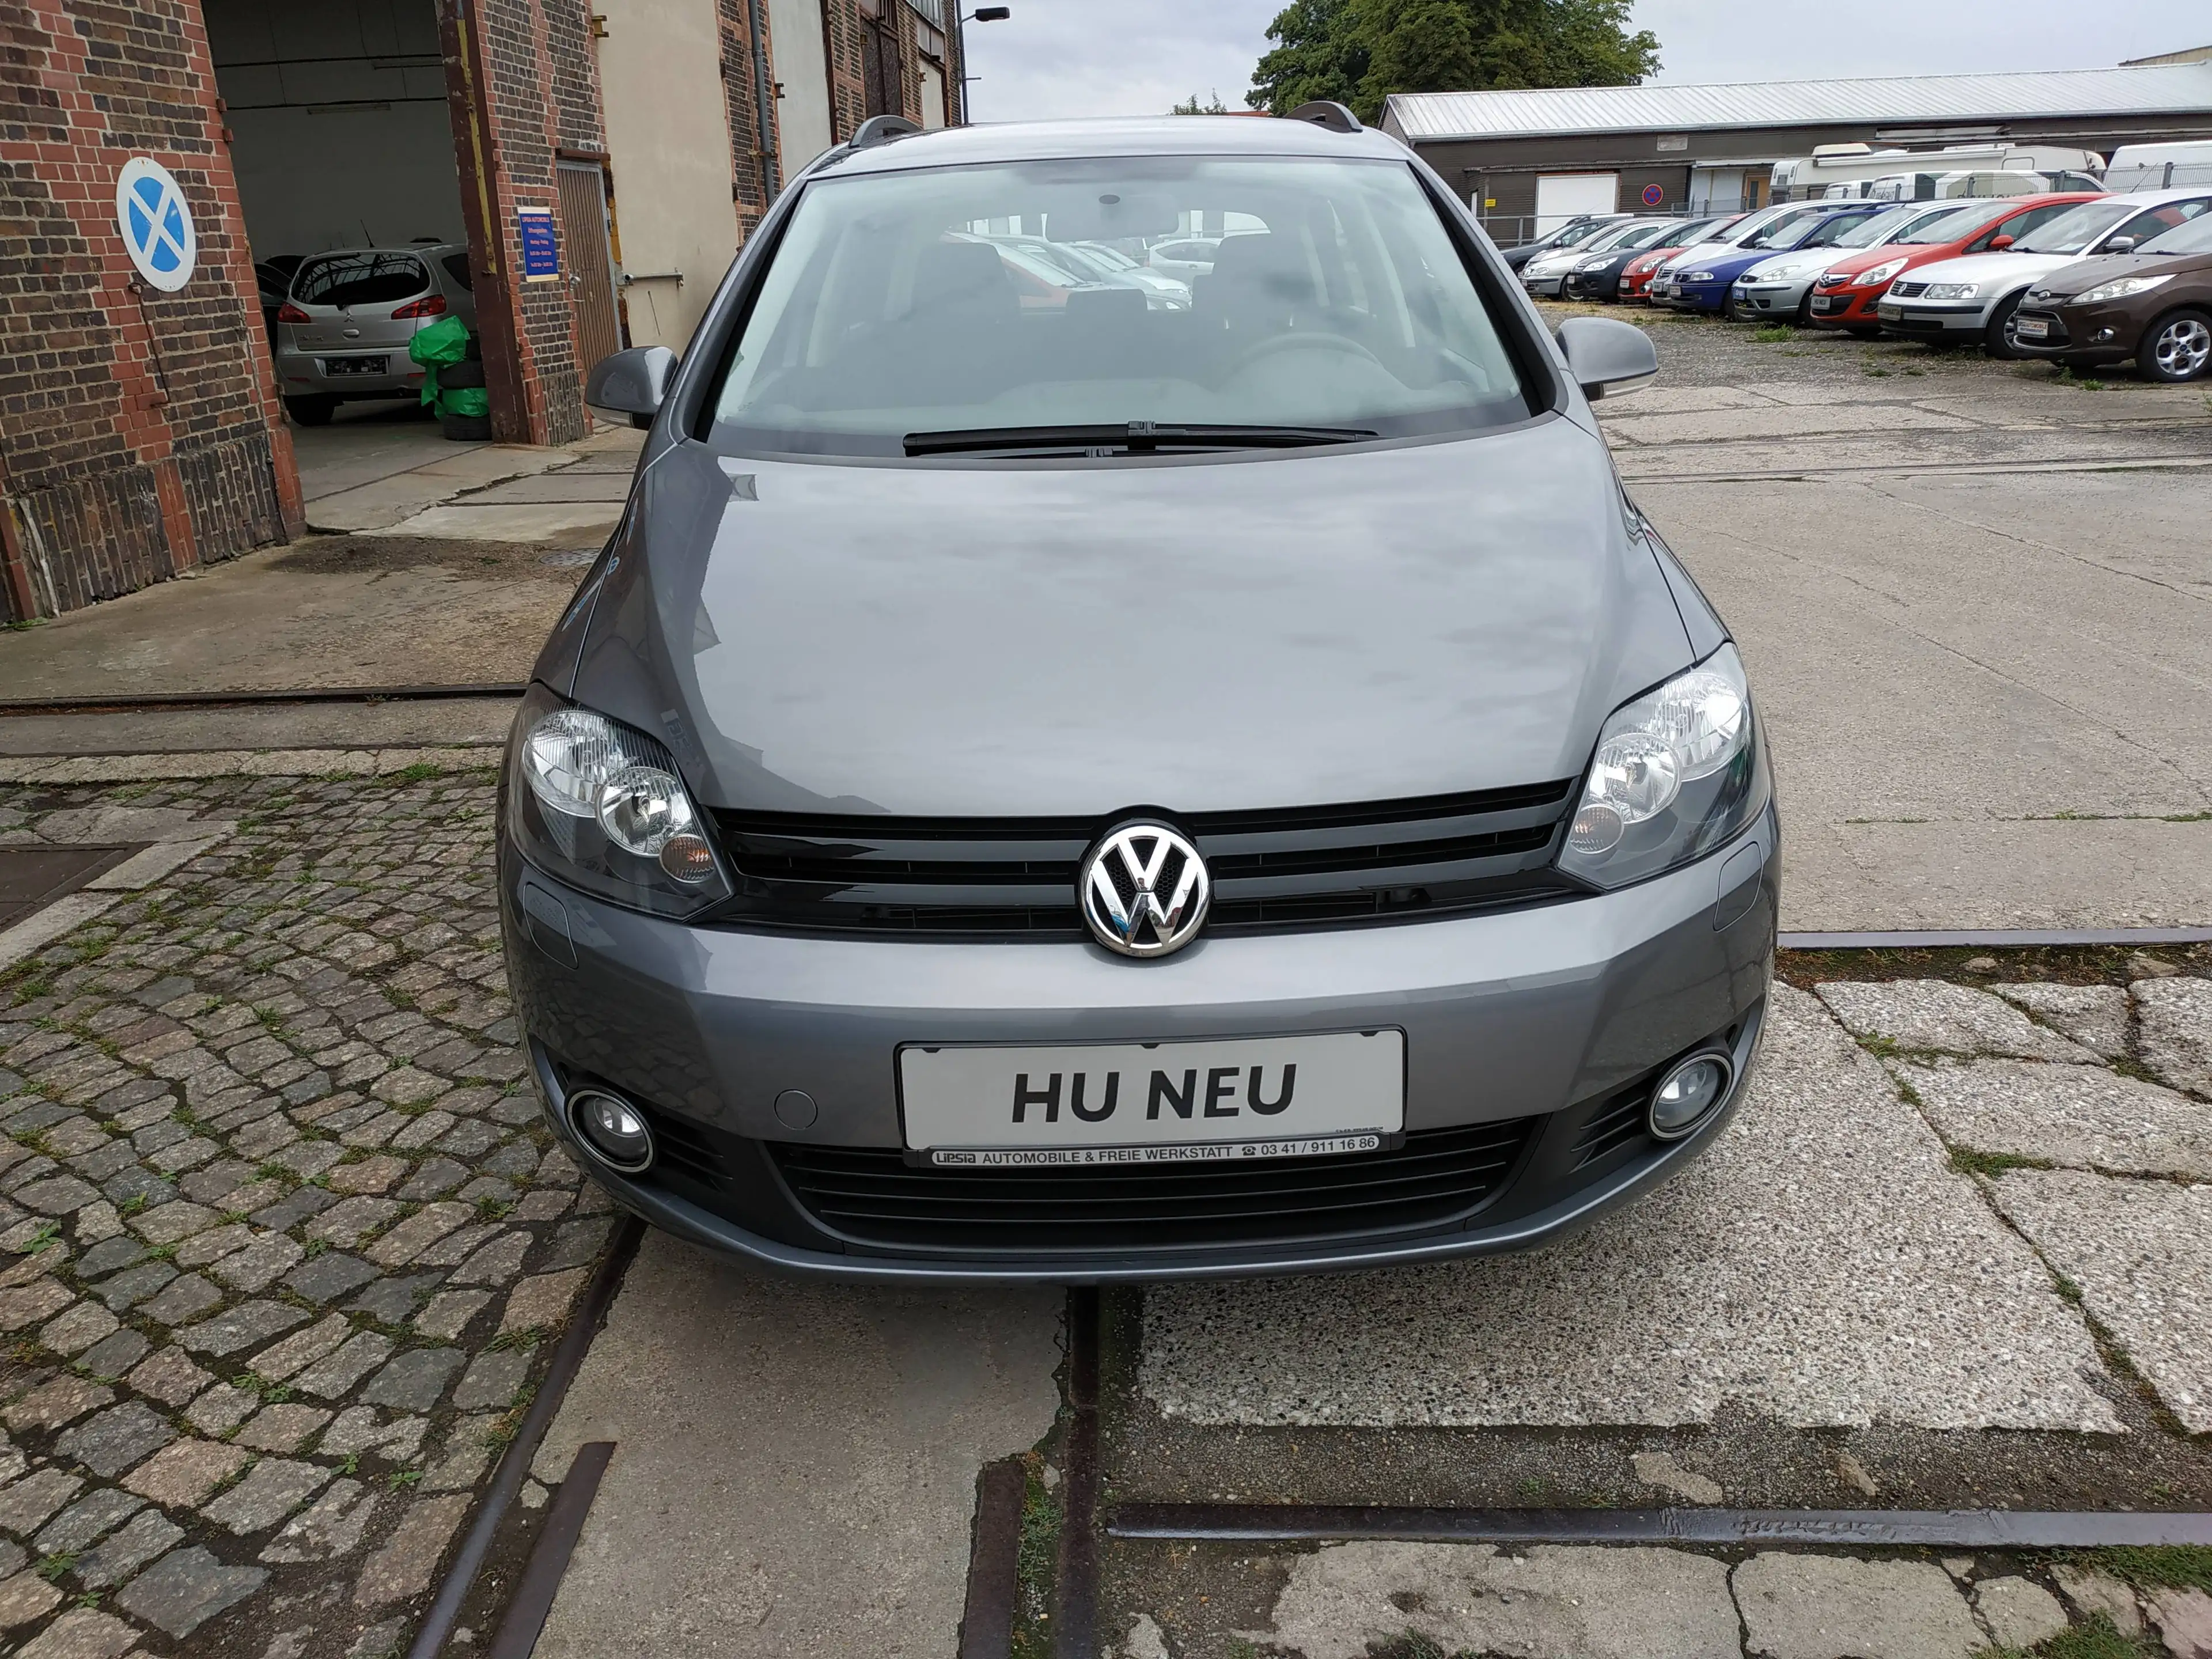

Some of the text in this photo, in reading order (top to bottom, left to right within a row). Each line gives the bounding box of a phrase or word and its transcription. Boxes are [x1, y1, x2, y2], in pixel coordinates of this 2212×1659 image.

[1012, 1064, 1297, 1122] HU NEU
[983, 1151, 1081, 1164] AUTOMOBILE
[1085, 1150, 1094, 1161] &
[1099, 1150, 1141, 1161] FREIE
[1145, 1146, 1233, 1160] WERKSTATT
[1262, 1145, 1278, 1155] 03
[1282, 1143, 1296, 1154] 41
[1302, 1142, 1308, 1153] /
[1311, 1141, 1334, 1152] 911
[1340, 1139, 1355, 1150] 16
[1359, 1138, 1375, 1148] 86
